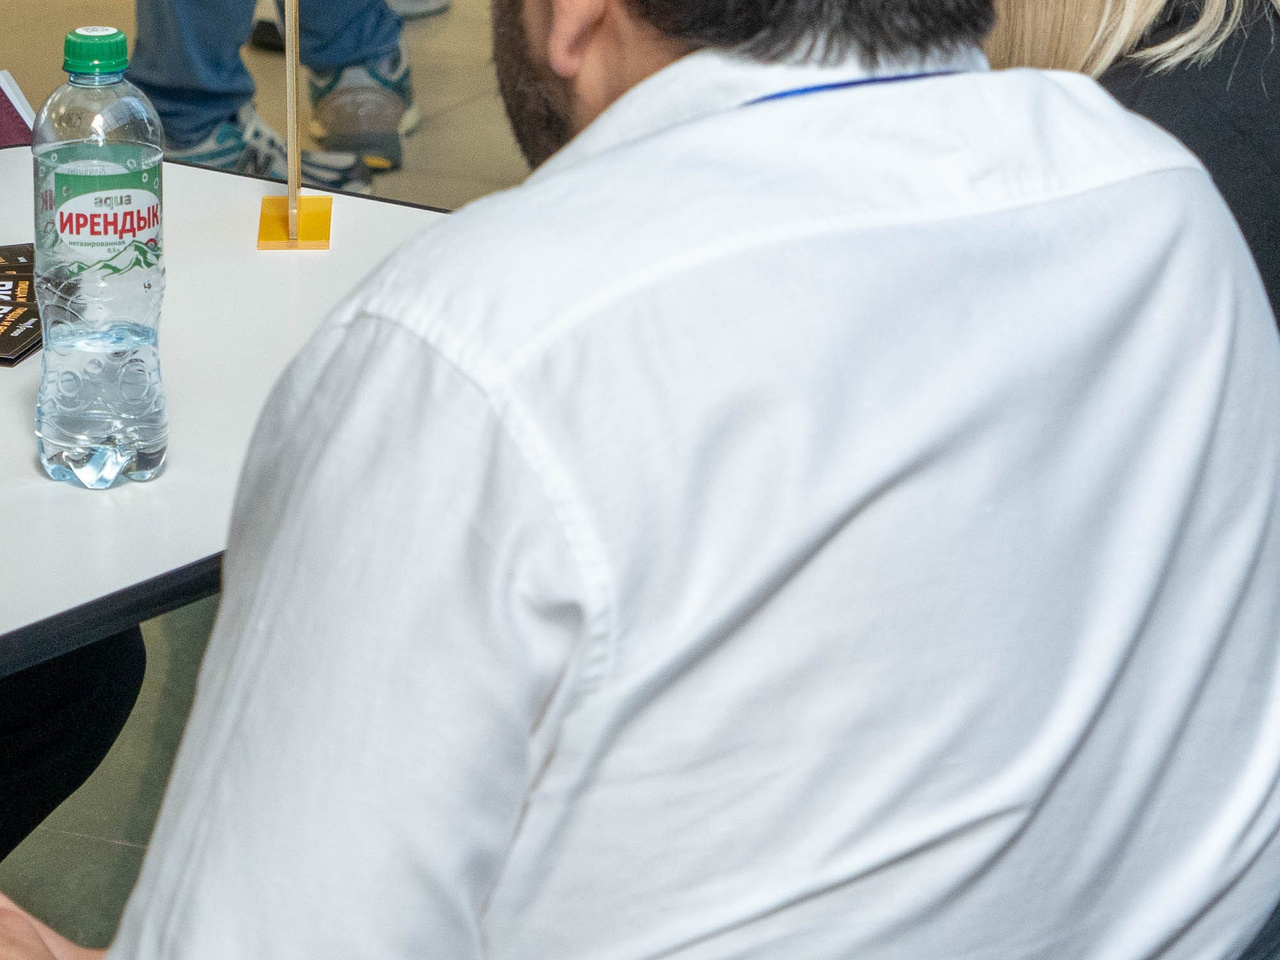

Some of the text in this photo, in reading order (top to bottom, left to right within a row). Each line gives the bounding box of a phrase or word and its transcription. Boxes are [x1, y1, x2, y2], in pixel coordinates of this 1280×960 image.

[94, 195, 131, 210] aqua
[59, 203, 160, 240] ИРЕНДЫК
[68, 240, 126, 248] негазированная
